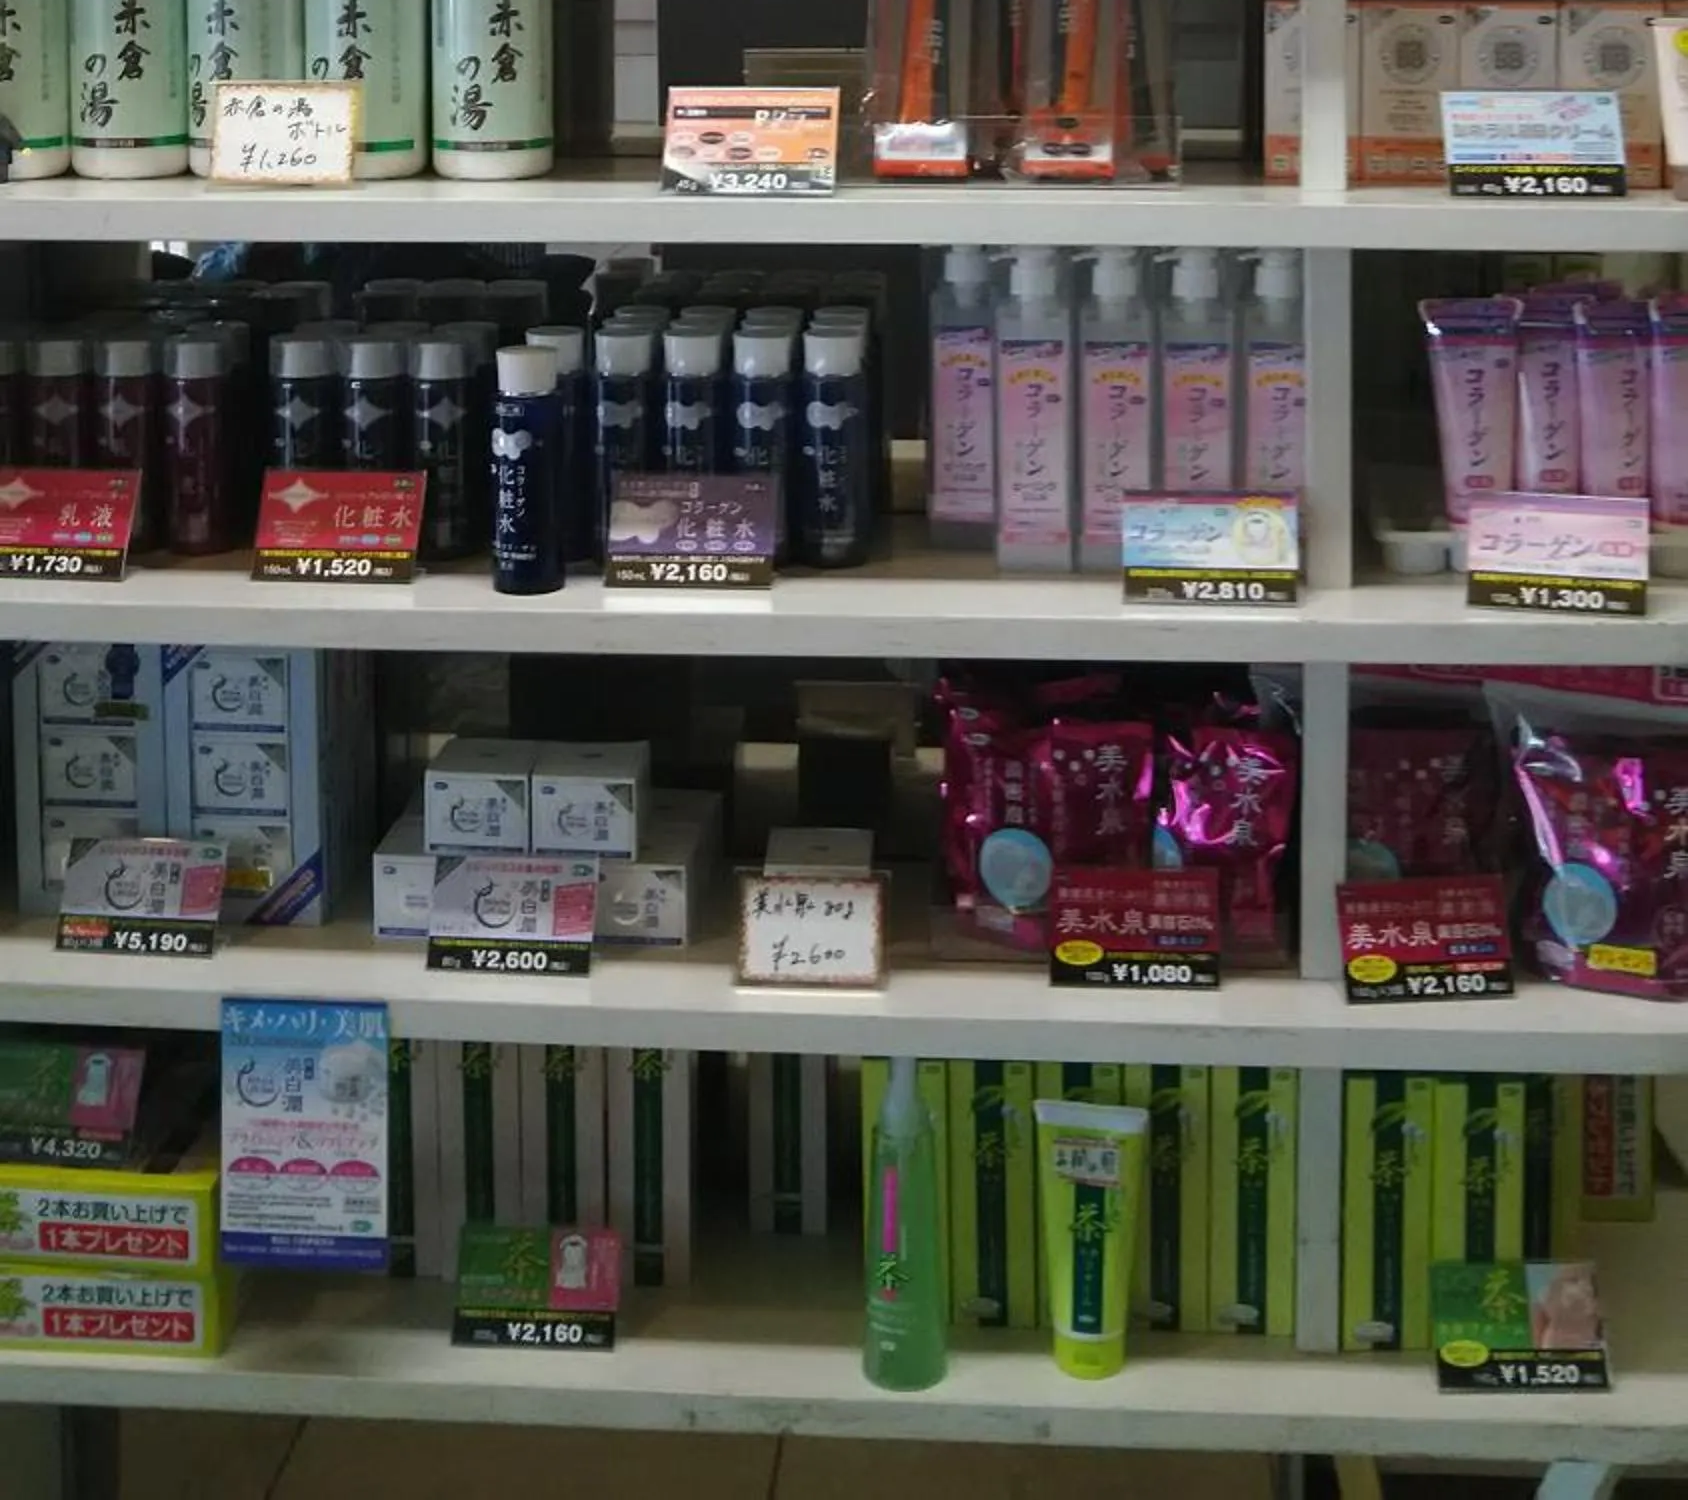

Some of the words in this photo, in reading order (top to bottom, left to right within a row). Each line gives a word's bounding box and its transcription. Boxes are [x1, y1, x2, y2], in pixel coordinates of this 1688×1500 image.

[708, 173, 788, 190] ¥3,240
[1503, 176, 1588, 194] ¥2,160
[1025, 383, 1048, 477] コラーゲン
[1109, 385, 1130, 478] コラーゲン
[498, 464, 517, 535] 化粧水
[680, 499, 744, 516] コラーゲン
[58, 502, 115, 529] 乳液
[334, 505, 415, 530] 化粧水
[676, 517, 757, 540] 化粧水
[1127, 521, 1224, 543] コラーゲン
[1478, 533, 1596, 560] コラーゲン
[10, 553, 83, 574] ¥1,730
[296, 557, 372, 578] ¥1,520
[649, 562, 728, 583] ¥2,160
[1181, 581, 1265, 601] ¥2,810
[1518, 587, 1605, 609] ¥1,300
[1056, 908, 1148, 936] 美水泉
[113, 930, 188, 952] ¥5,190
[1346, 919, 1440, 950] 美水泉
[471, 949, 548, 971] ¥2,600
[1111, 962, 1193, 985] ¥1,080
[1406, 974, 1487, 997] ¥2,160
[223, 1005, 386, 1038] キメ・ハリ・美肌
[29, 1137, 101, 1160] ¥4,320
[37, 1198, 190, 1226] 2本お買い上げで
[45, 1227, 182, 1256] 1本プレゼント
[41, 1283, 195, 1309] 2本お買い上げで
[51, 1311, 191, 1341] 1本プレゼント
[506, 1322, 584, 1343] ¥2,160
[1497, 1362, 1581, 1384] ¥1,520
